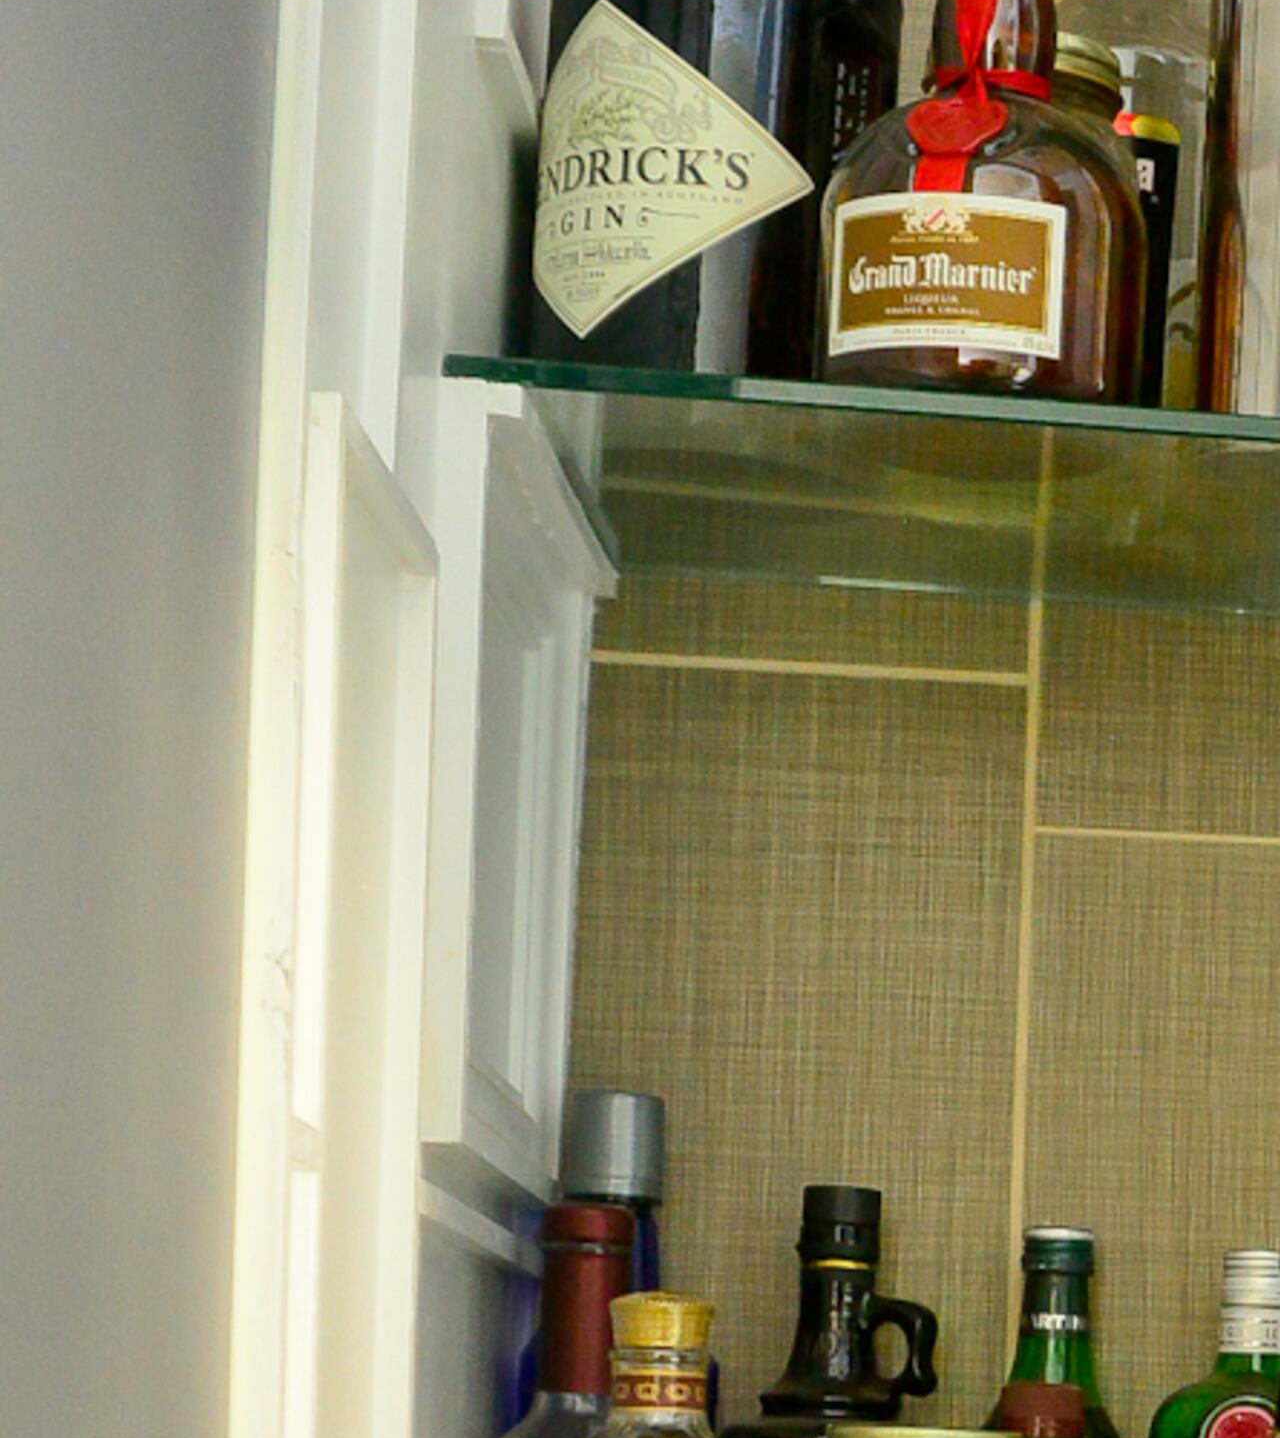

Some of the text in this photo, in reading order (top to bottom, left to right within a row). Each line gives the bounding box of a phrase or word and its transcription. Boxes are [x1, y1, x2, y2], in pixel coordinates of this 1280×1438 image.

[536, 145, 750, 197] NDRICK'S
[560, 204, 627, 236] GIN
[849, 252, 1033, 295] Grand Marnier
